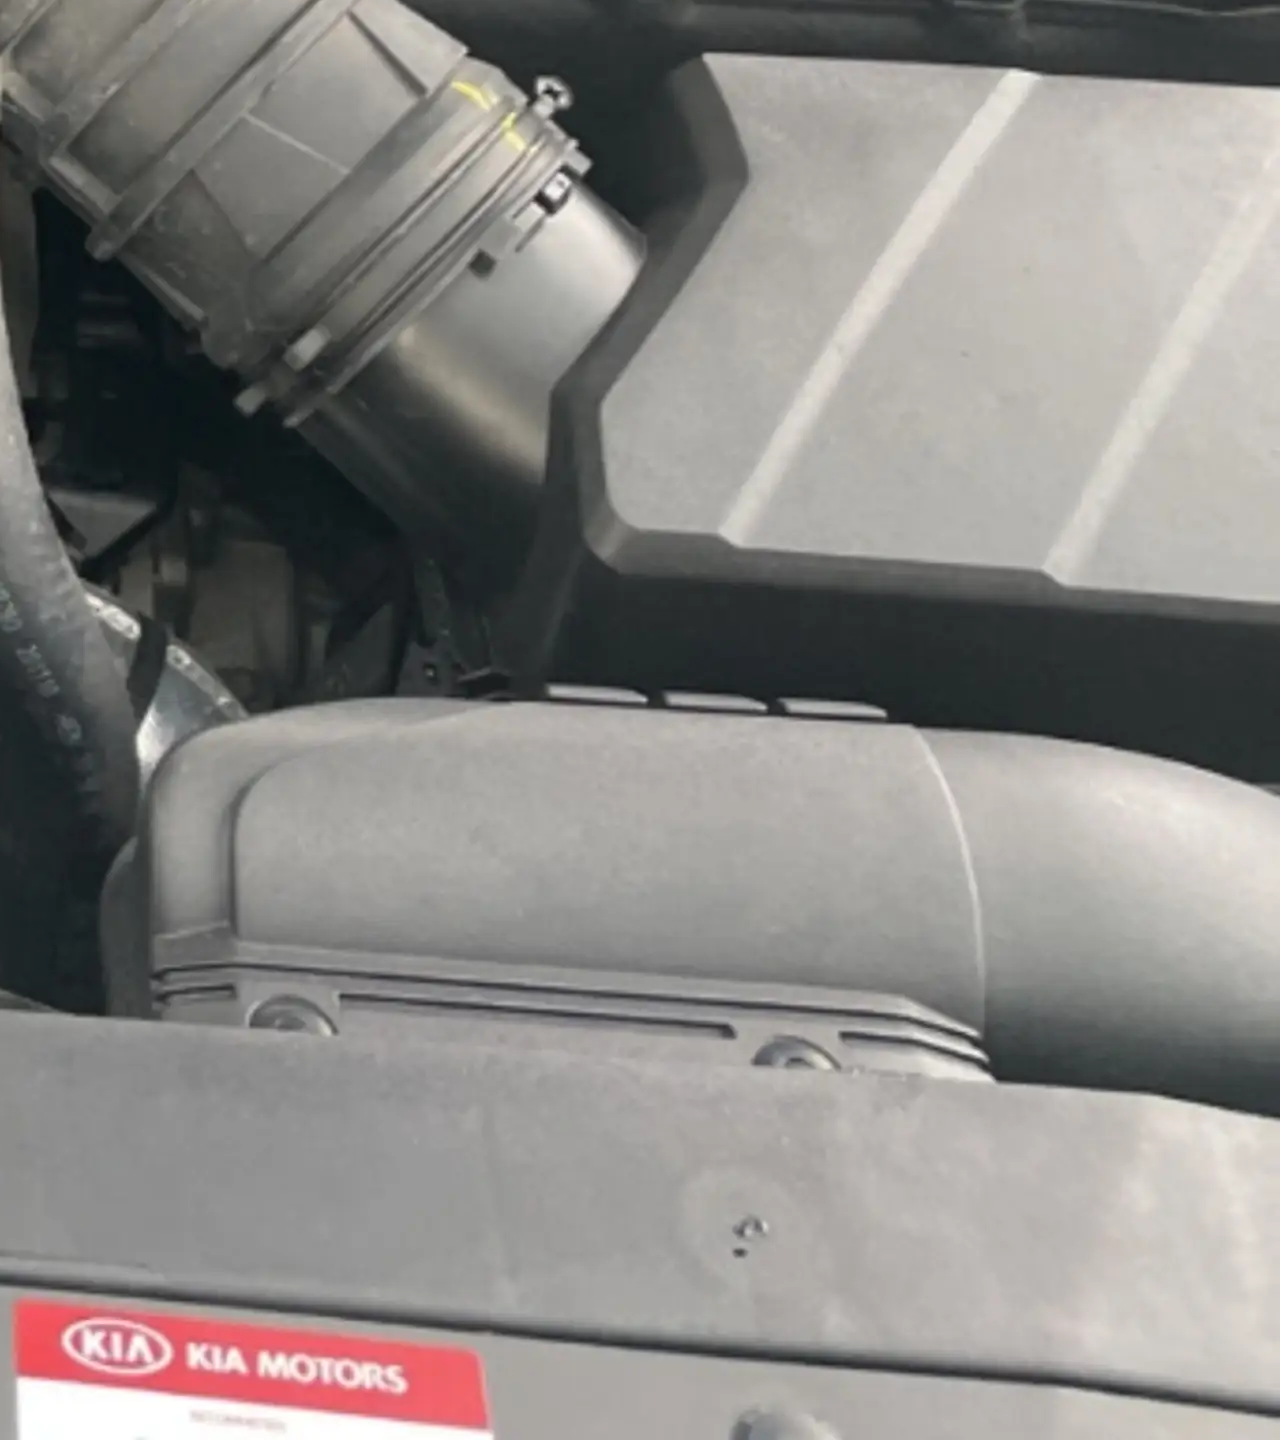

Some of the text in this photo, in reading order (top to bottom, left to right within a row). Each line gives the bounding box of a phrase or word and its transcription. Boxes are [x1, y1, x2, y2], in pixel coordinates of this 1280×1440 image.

[80, 1326, 155, 1366] KIA
[185, 1341, 409, 1395] KIA MOTORS
